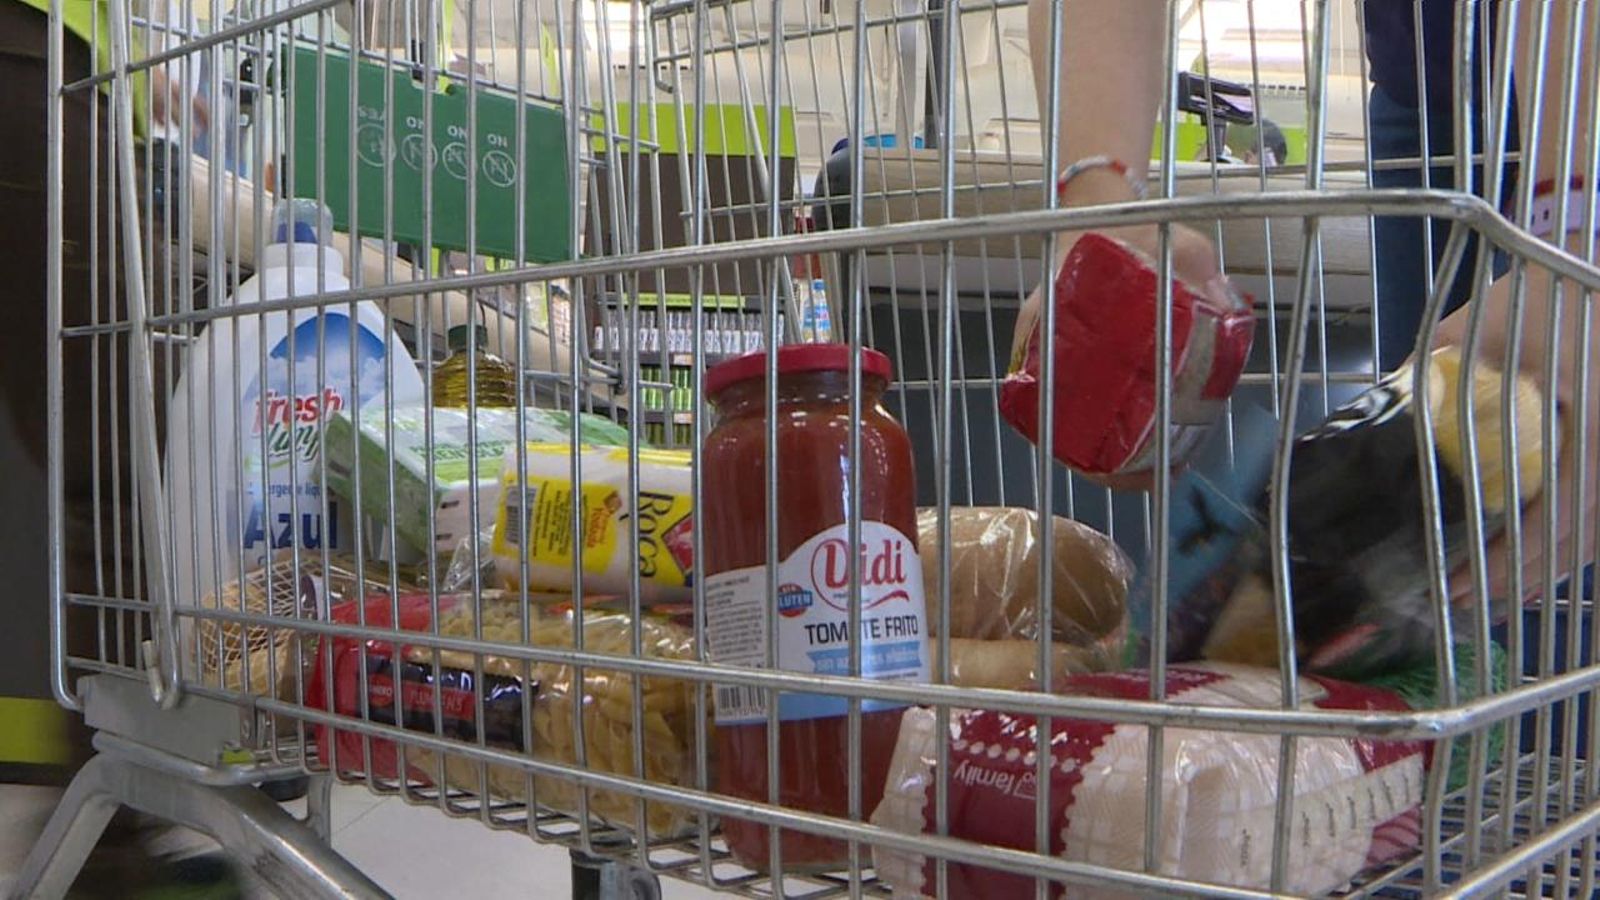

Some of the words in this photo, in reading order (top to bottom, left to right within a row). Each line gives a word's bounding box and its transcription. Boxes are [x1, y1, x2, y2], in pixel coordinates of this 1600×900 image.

[447, 125, 468, 139] NO
[487, 133, 508, 148] NO
[253, 388, 345, 430] fresh
[244, 501, 338, 549] Azul
[778, 593, 811, 607] LUTEN
[804, 619, 881, 645] TOMTE
[885, 615, 919, 637] FRITO
[953, 759, 1016, 795] family
